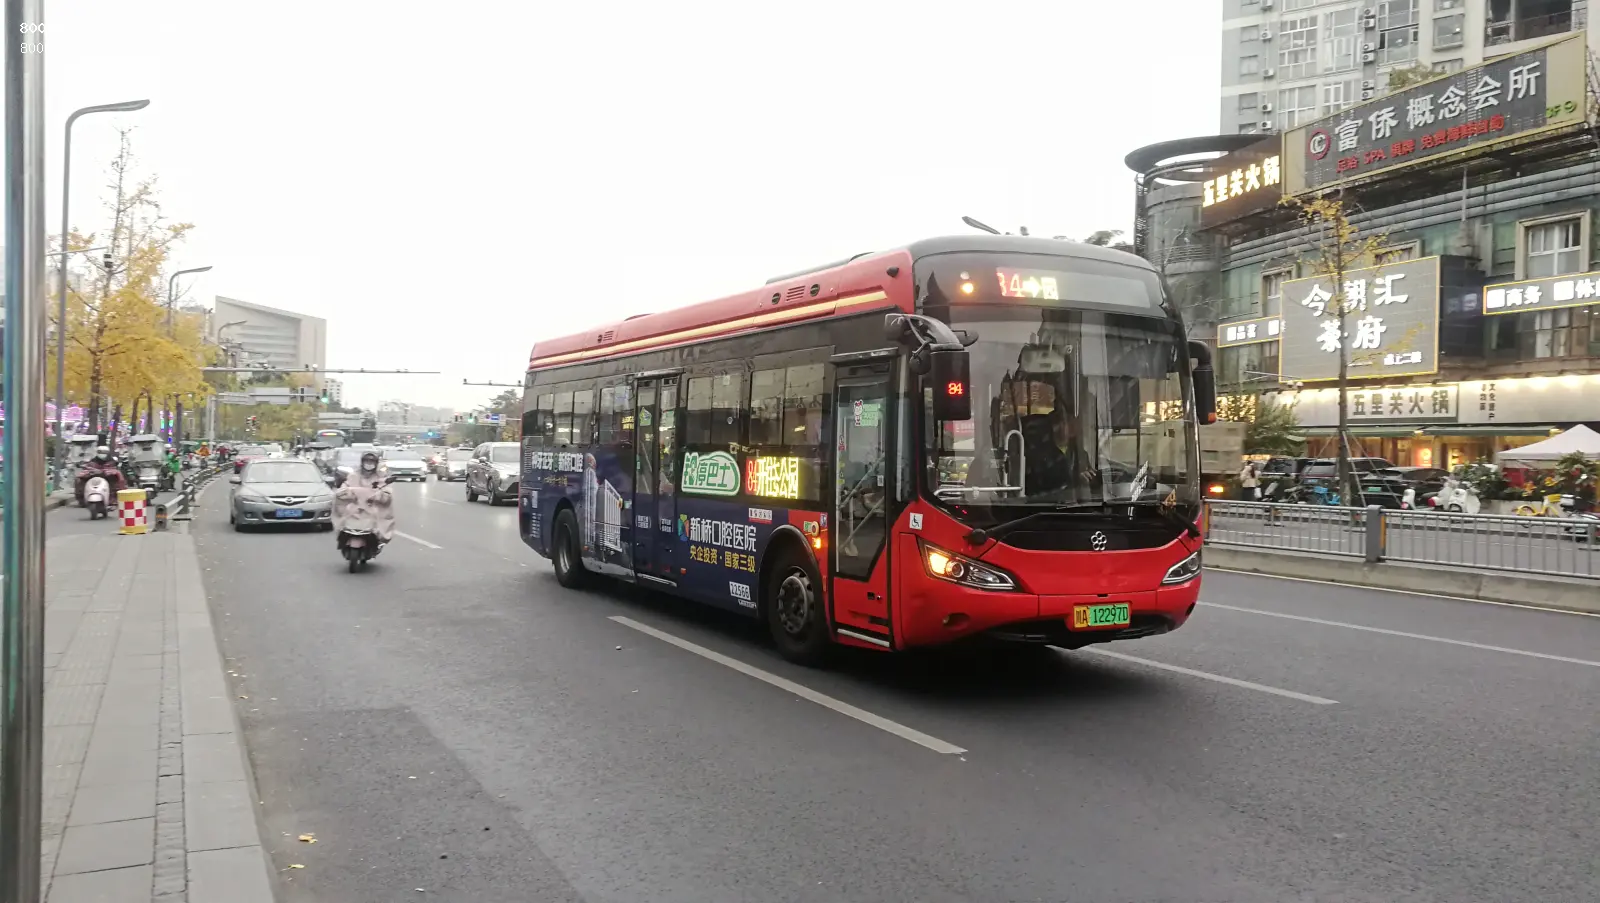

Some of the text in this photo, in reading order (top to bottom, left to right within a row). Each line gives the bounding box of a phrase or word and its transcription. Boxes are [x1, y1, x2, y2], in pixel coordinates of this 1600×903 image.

[1335, 61, 1541, 152] 富侨概念会所
[1203, 155, 1280, 208] 五里关火锅
[1301, 273, 1409, 317] 今朝汇
[948, 382, 963, 395] 84
[1353, 390, 1449, 415] 五里关火锅
[690, 517, 757, 552] 新桥口腔医院
